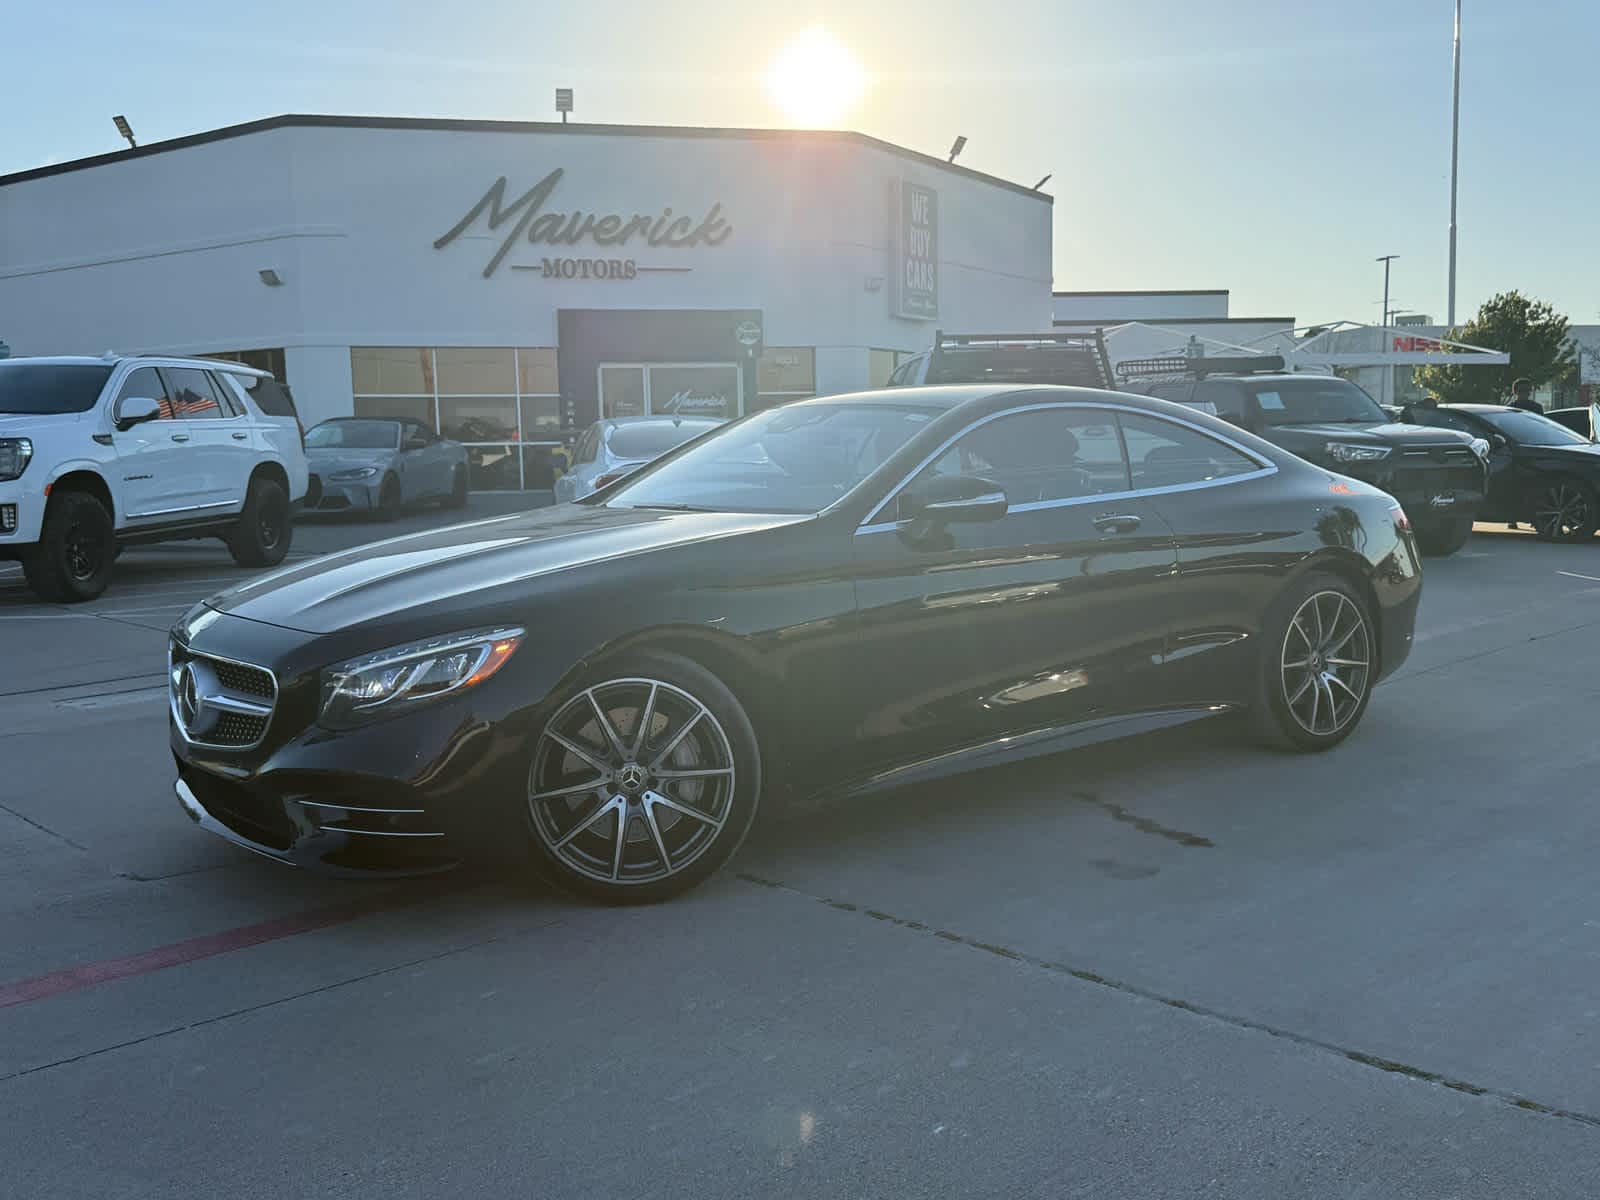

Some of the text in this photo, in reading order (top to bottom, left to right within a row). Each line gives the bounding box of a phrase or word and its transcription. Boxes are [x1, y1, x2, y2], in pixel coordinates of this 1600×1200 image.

[911, 191, 929, 224] WE
[432, 167, 734, 279] Maverick
[910, 229, 930, 257] BUY
[541, 258, 636, 280] MOTORS
[906, 260, 935, 291] CARS
[1393, 336, 1441, 352] NISS
